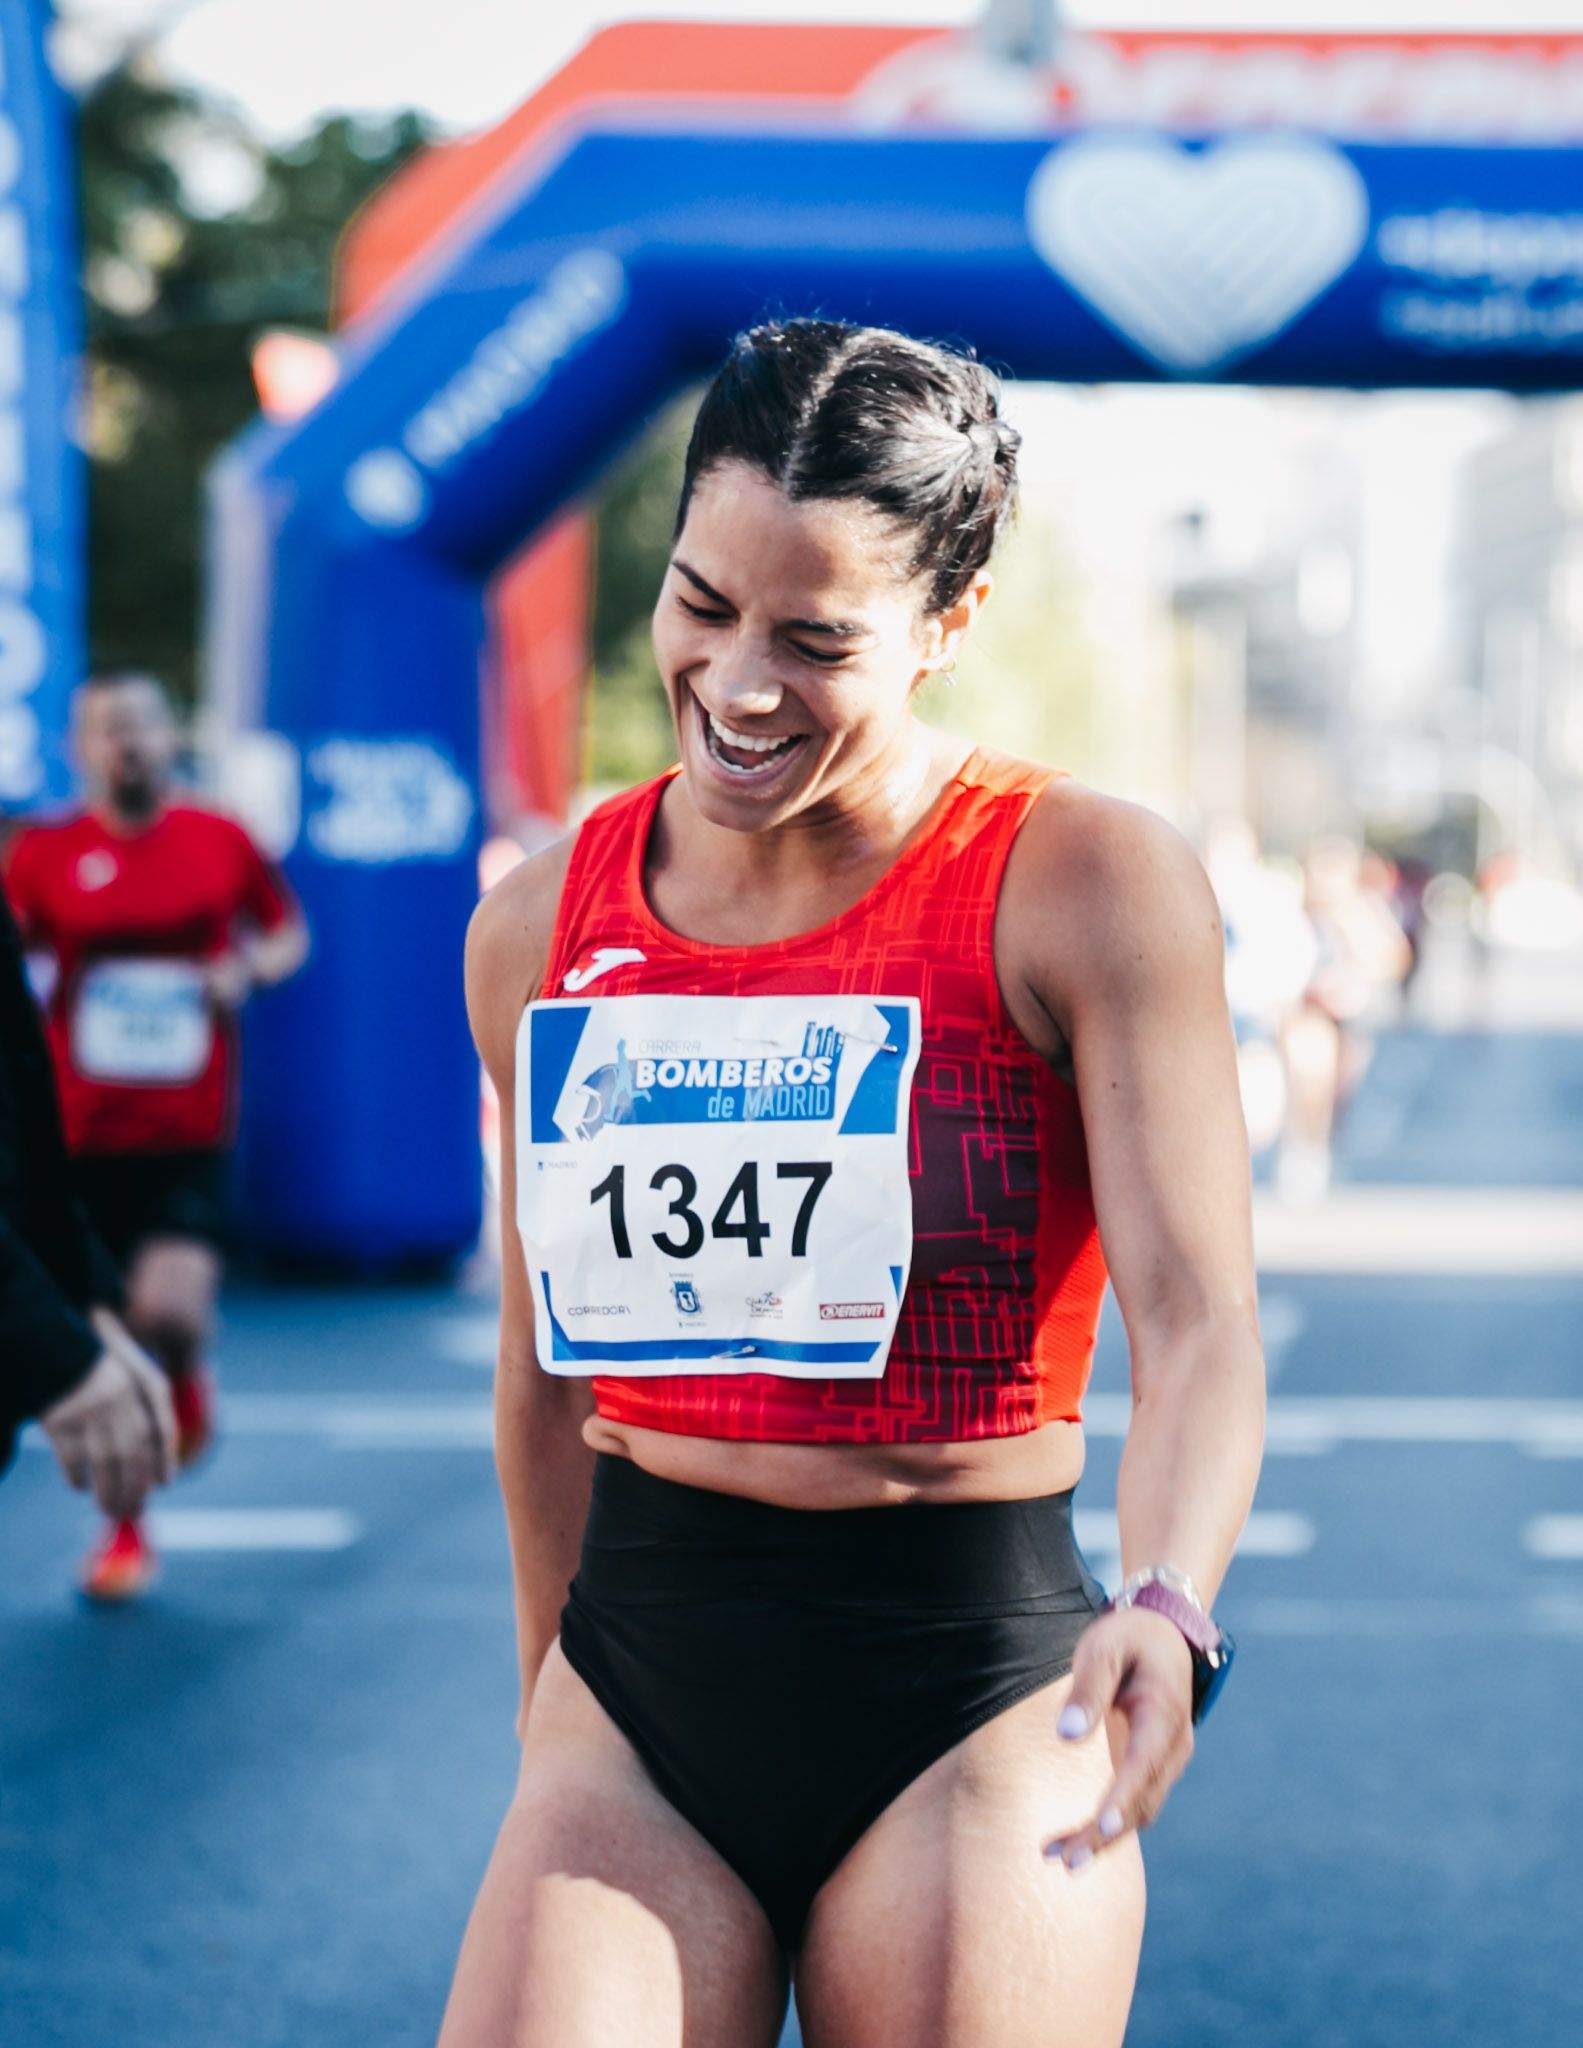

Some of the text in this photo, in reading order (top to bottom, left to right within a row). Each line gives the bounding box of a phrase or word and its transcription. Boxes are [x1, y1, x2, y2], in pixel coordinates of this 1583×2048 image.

[637, 1038, 702, 1055] CARRERA
[635, 1056, 833, 1089] BOMBEROS
[707, 1084, 831, 1120] de MADRID
[590, 1161, 833, 1259] 1347
